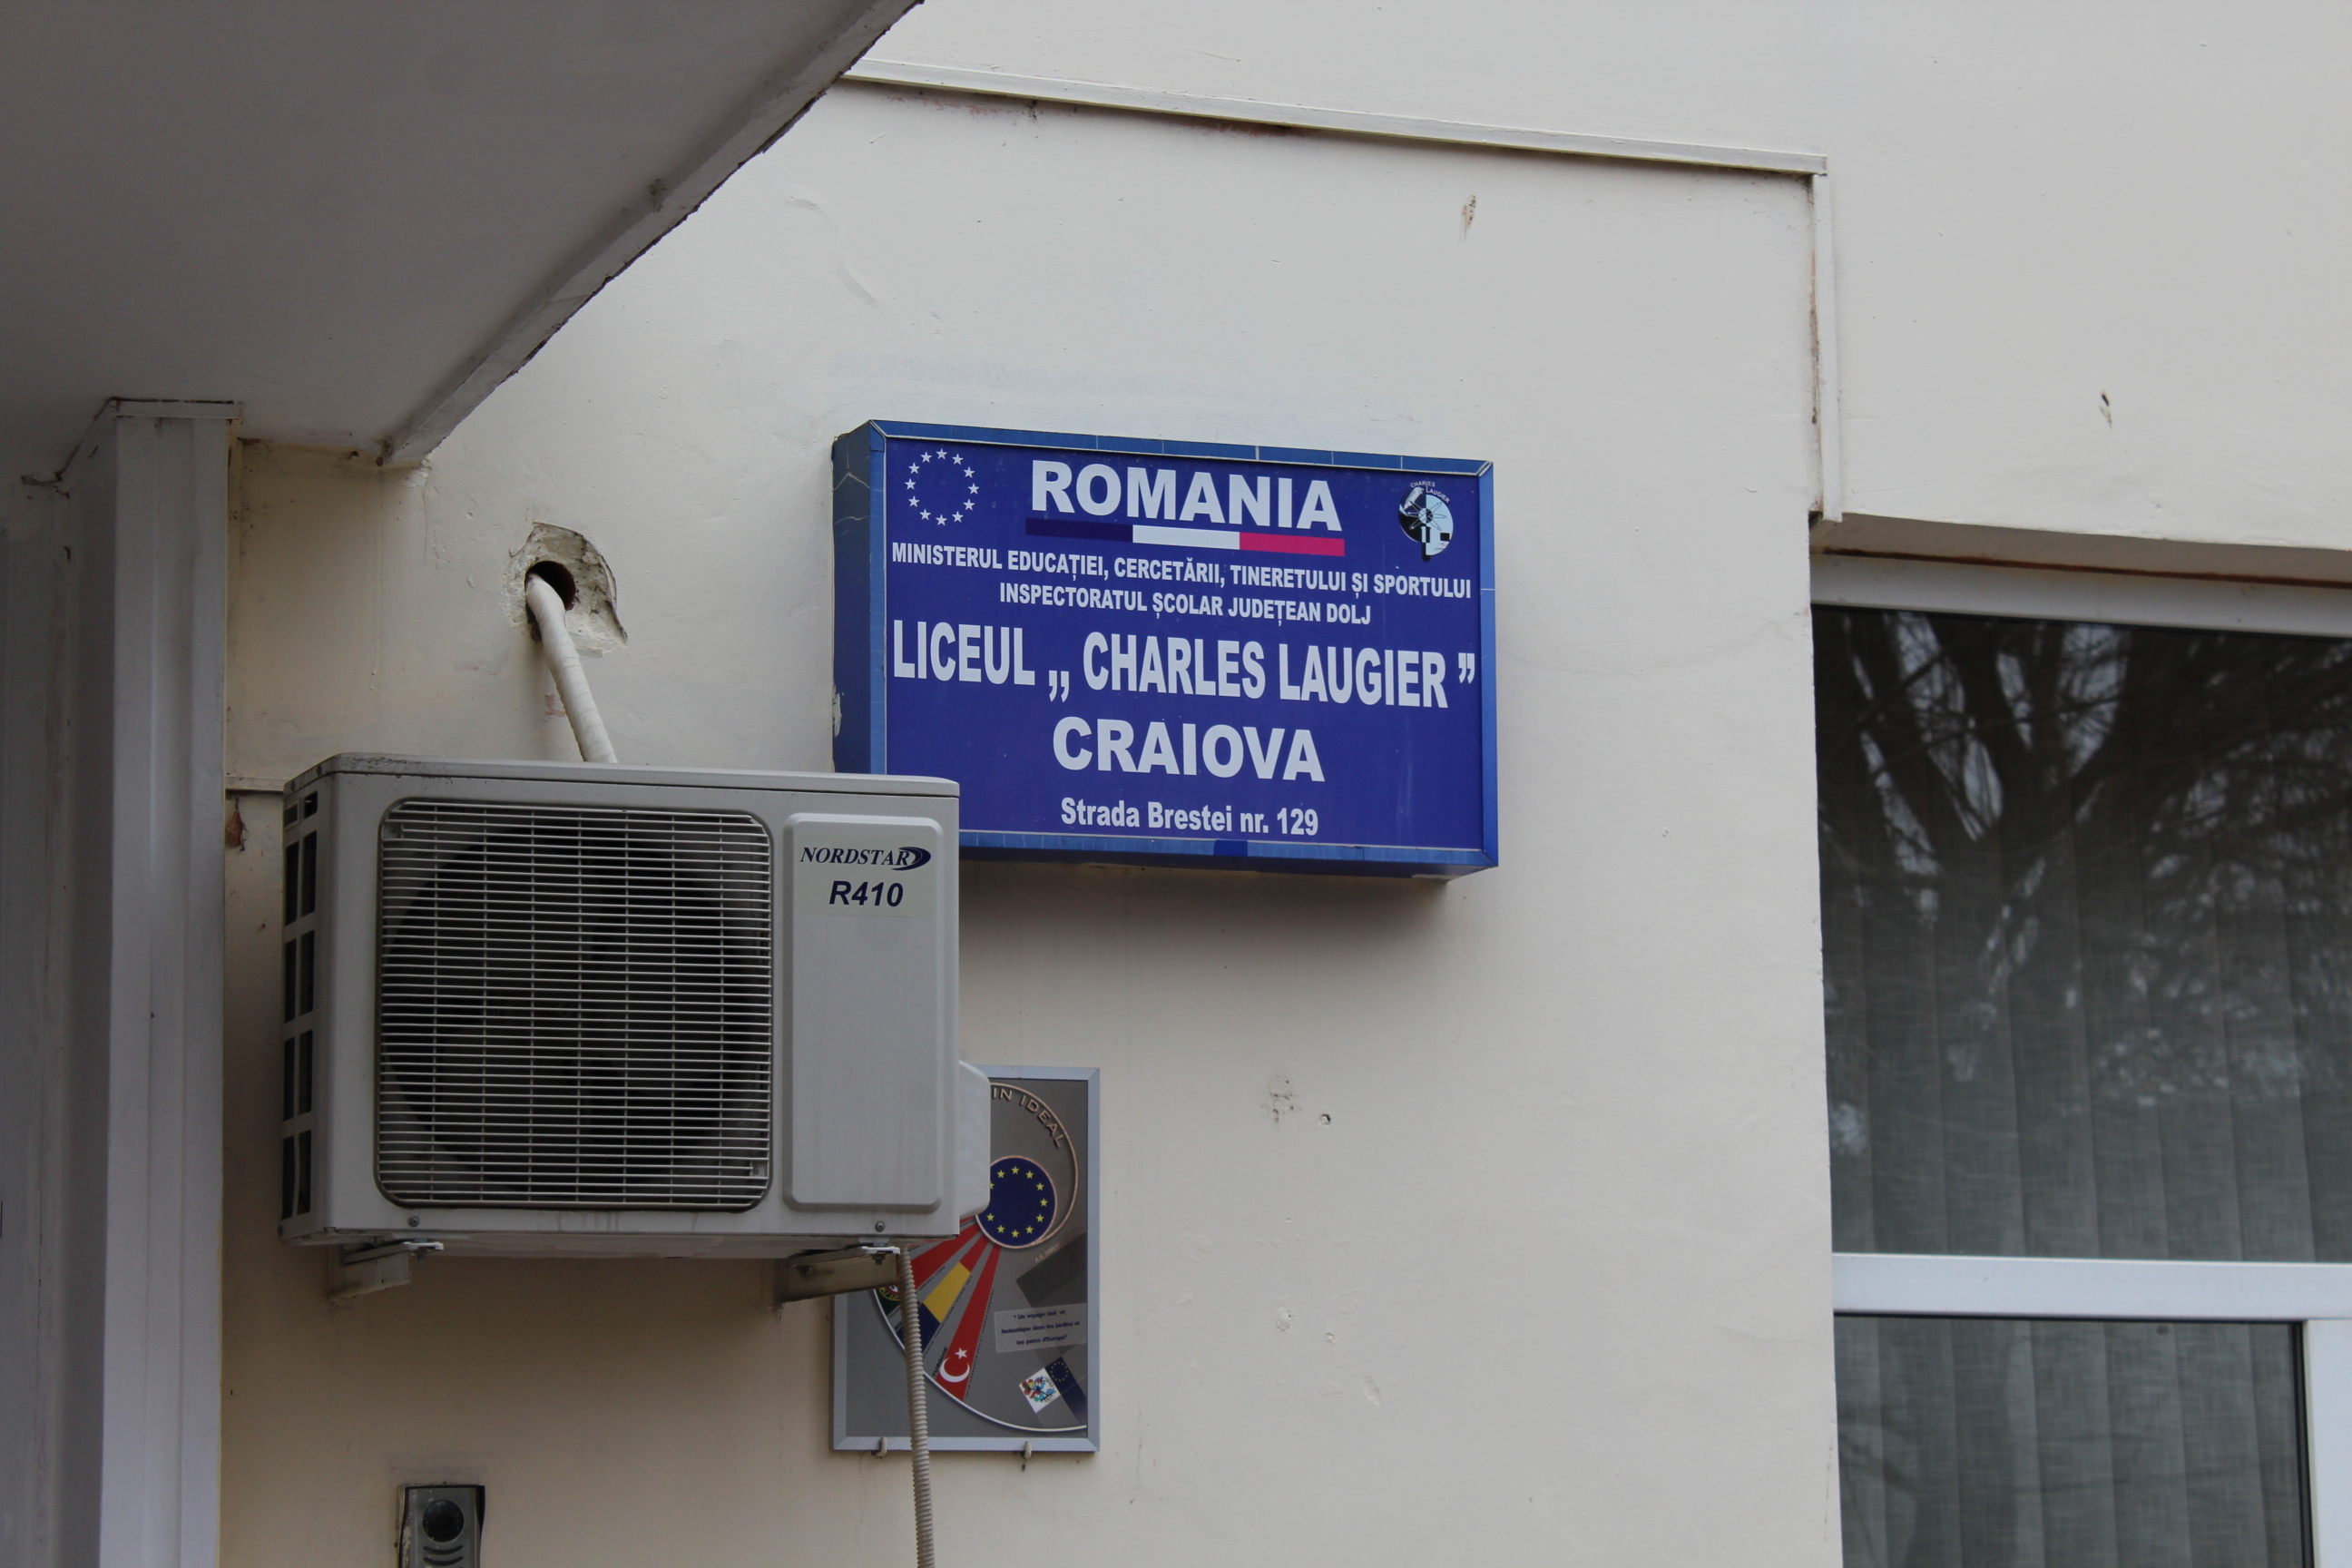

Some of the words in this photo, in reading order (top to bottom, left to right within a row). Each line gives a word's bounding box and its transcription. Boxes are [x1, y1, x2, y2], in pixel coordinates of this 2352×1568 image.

[1033, 460, 1341, 530] ROMANIA
[893, 543, 1002, 569] MINISTERUL
[1114, 557, 1224, 588] CERCETĂRII,
[1230, 565, 1346, 591] TINERETULUI
[1352, 573, 1367, 598] ȘI
[1374, 574, 1470, 598] SPORTULUI
[1001, 583, 1147, 611] INSPECTORATUL
[1152, 593, 1223, 619] ȘCOLAR
[1327, 603, 1370, 624] DOLJ
[894, 620, 1034, 685] LICEUL
[1083, 632, 1265, 699] CHARLES
[1279, 644, 1447, 708] LAUGIER
[1054, 717, 1325, 781] CRAIOVA
[1062, 798, 1140, 827] Strada
[1148, 802, 1231, 831] Brestei
[1240, 813, 1269, 833] nr.
[1278, 808, 1318, 836] 129
[800, 847, 910, 866] NORDSTAR
[828, 880, 904, 906] R410
[1019, 1094, 1063, 1148] IDEAL
